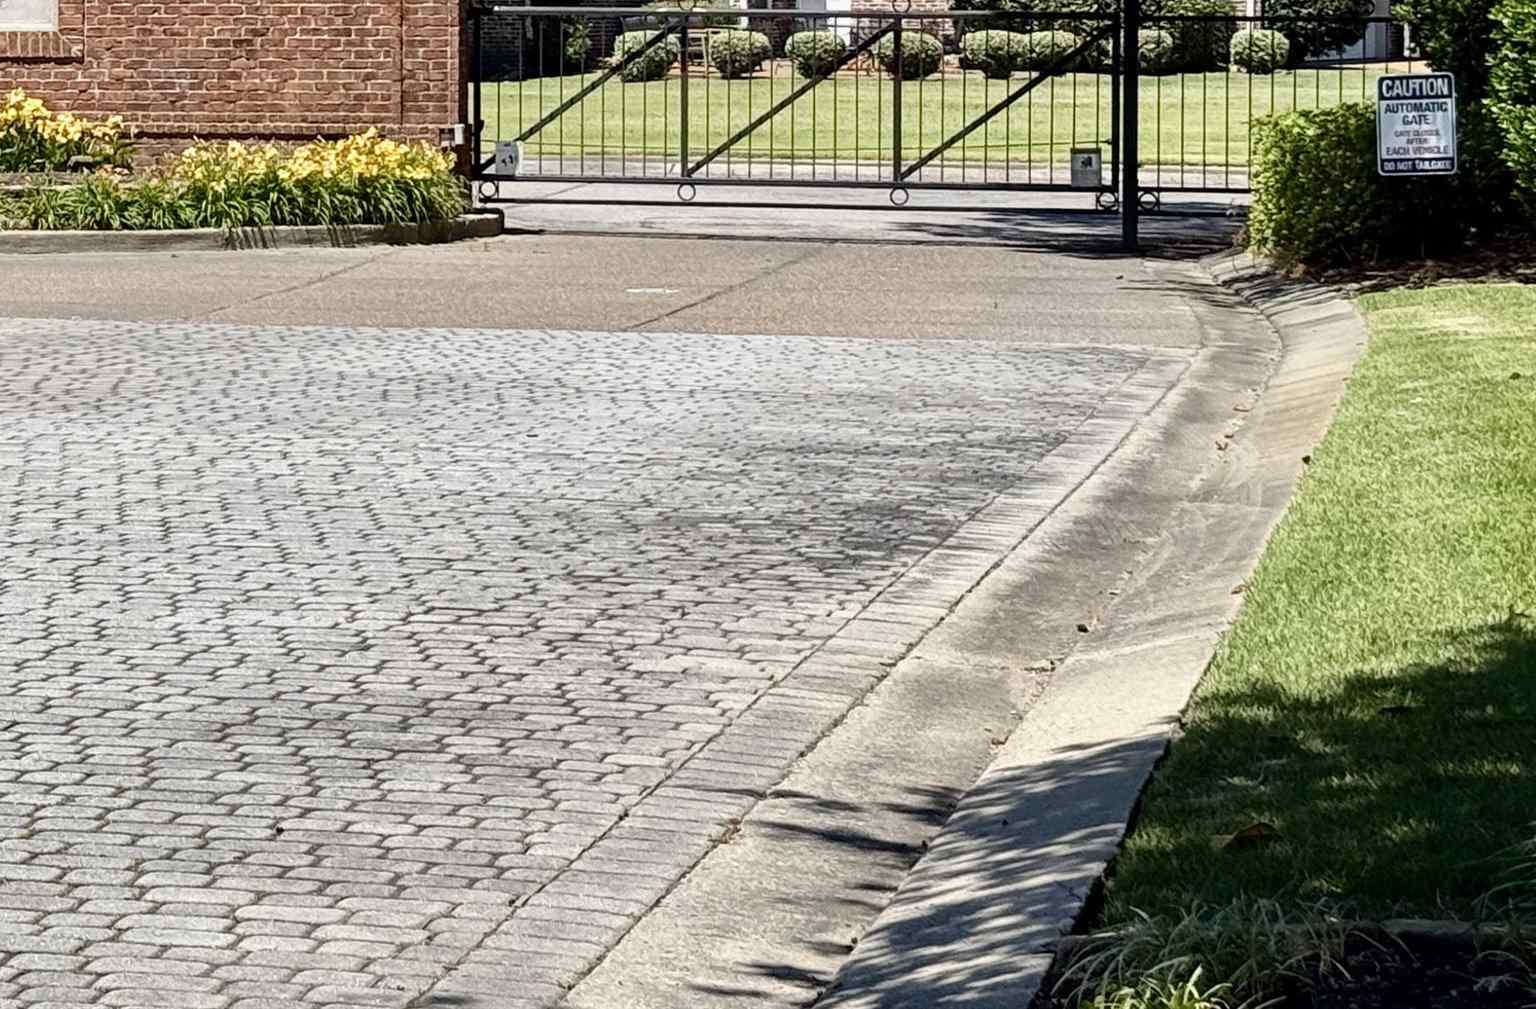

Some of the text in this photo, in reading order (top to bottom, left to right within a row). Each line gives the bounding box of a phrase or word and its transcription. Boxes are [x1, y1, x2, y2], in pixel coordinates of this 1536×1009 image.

[1383, 78, 1450, 97] CAUTION
[1384, 101, 1449, 114] AUTOMATIC
[1402, 114, 1432, 126] GATE
[1383, 161, 1396, 171] DO
[1397, 160, 1413, 171] NOT
